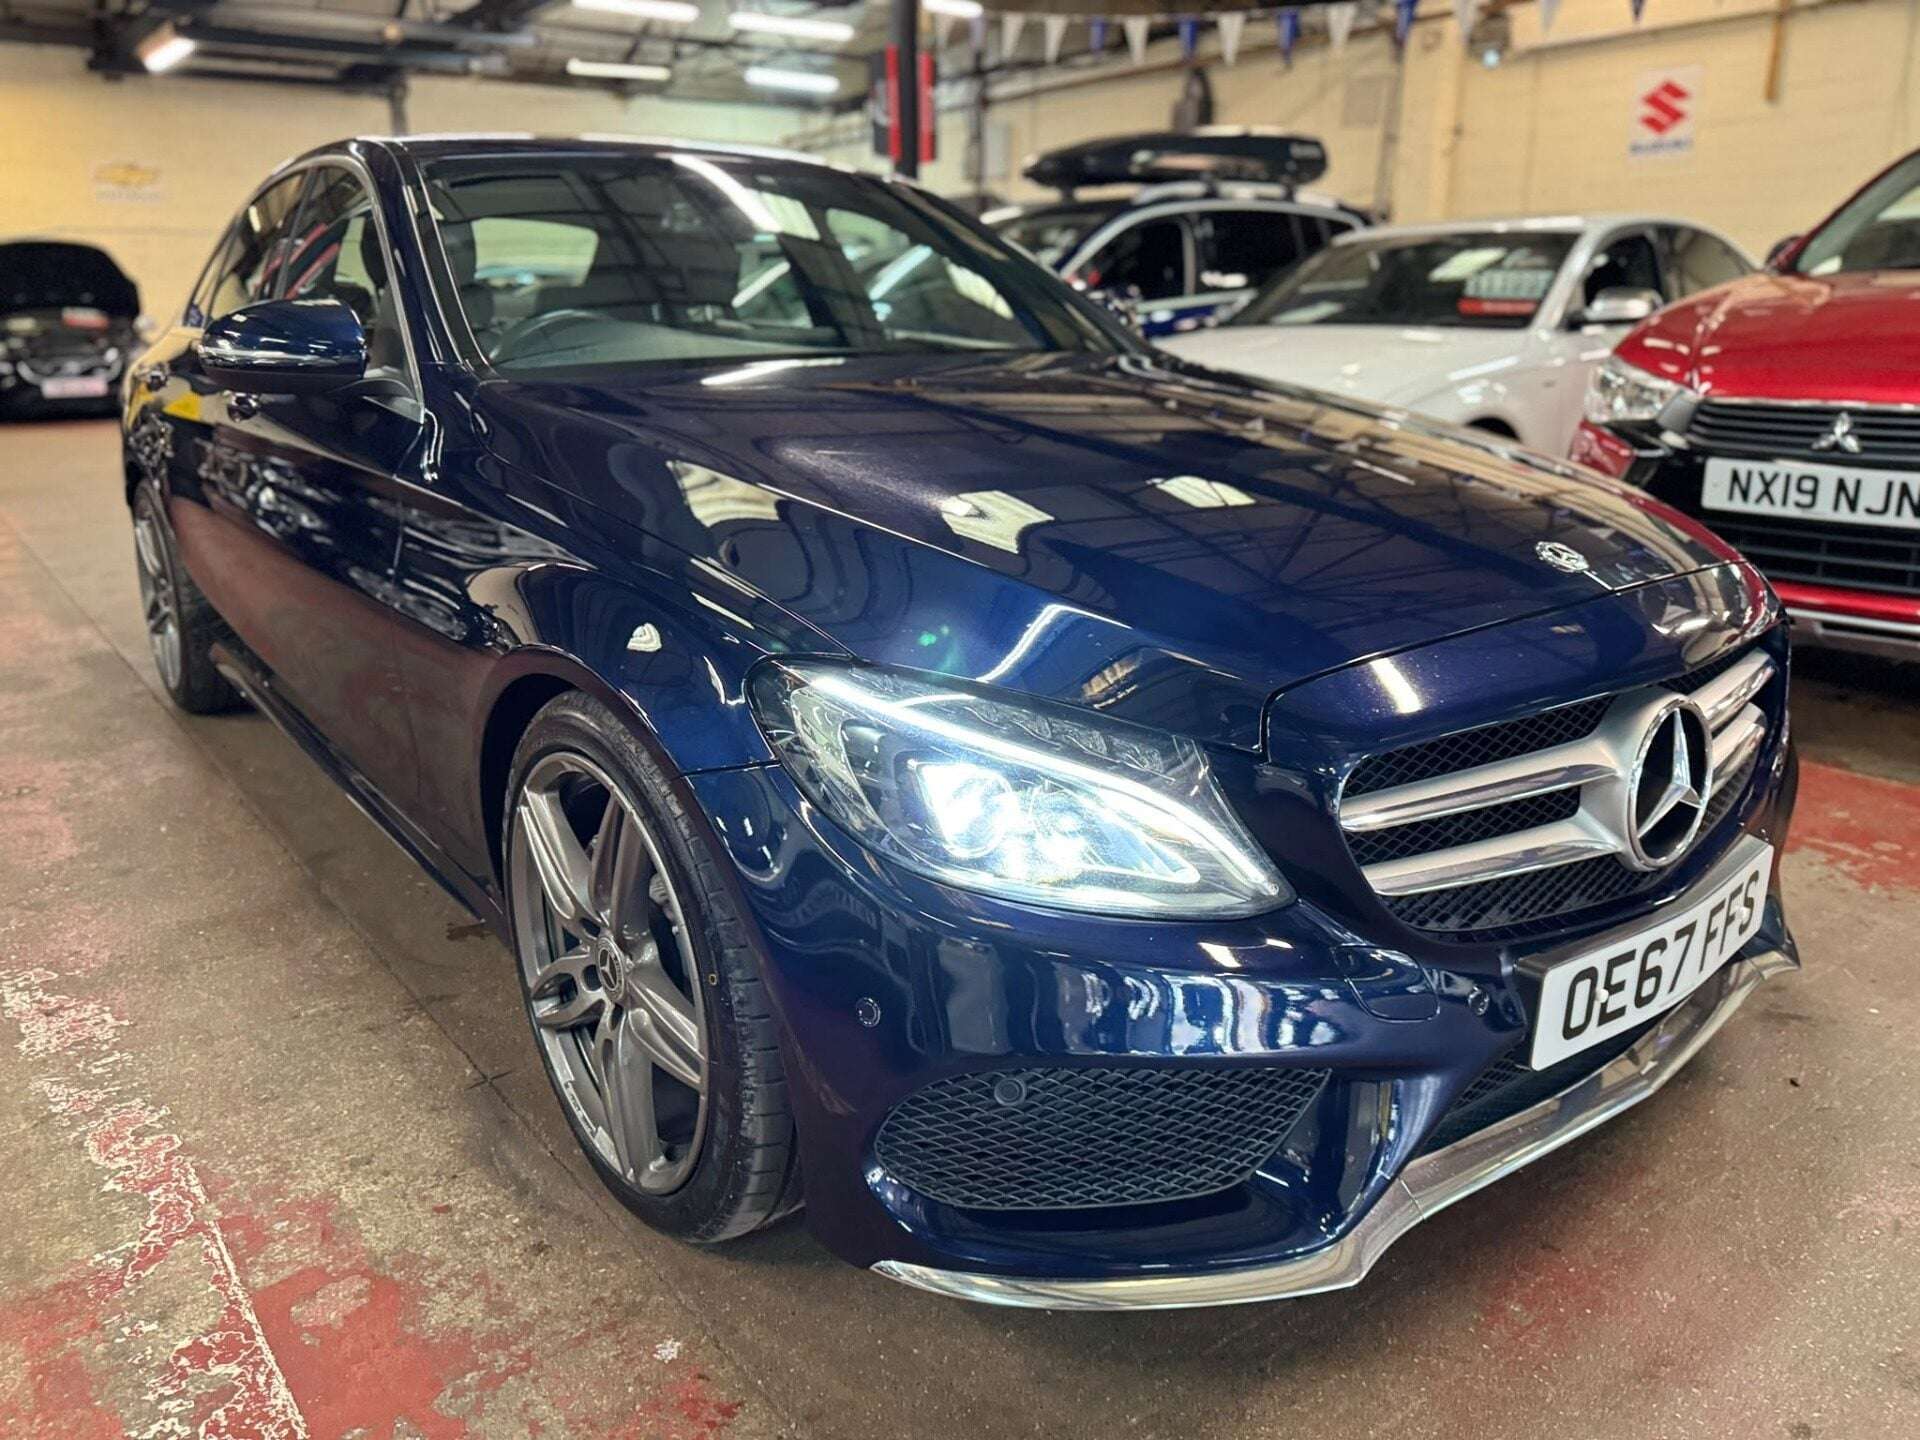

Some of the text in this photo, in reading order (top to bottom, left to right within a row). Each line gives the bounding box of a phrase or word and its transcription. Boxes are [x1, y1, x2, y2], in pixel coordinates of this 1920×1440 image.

[1728, 468, 1920, 518] NX19 NJN
[1562, 869, 1759, 1041] OE67 FFS
